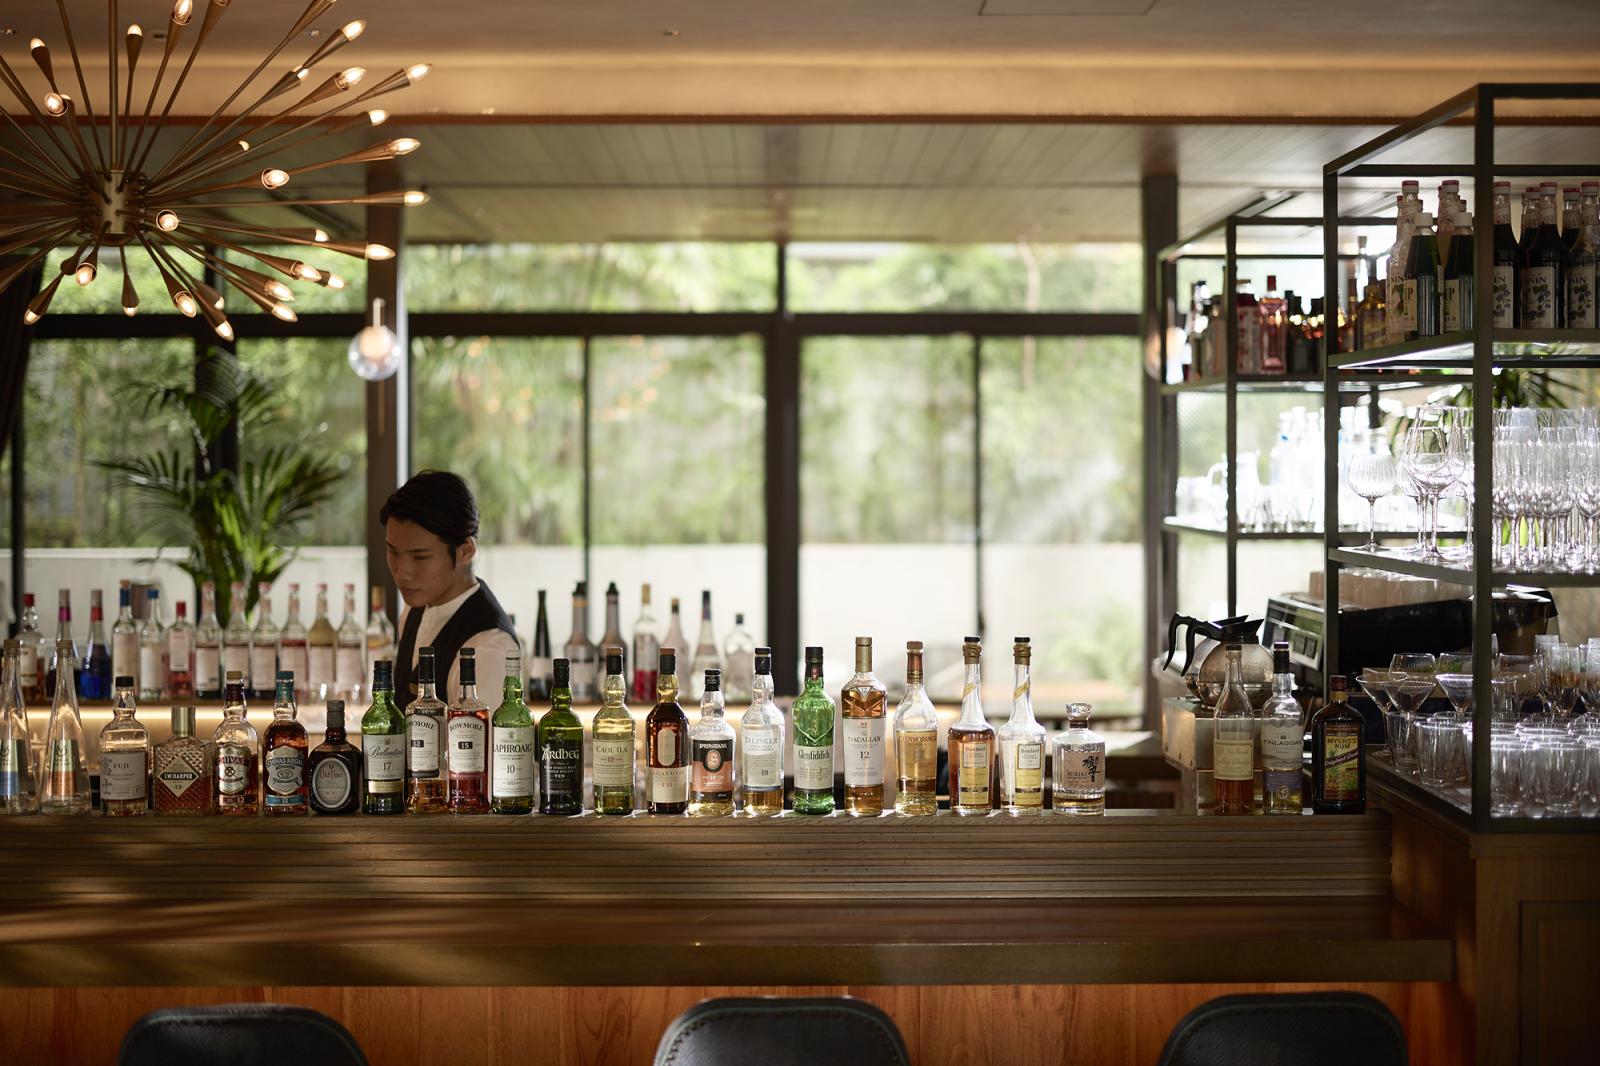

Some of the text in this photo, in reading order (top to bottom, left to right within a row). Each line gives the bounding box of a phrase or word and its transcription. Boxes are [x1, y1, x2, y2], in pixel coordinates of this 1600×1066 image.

[450, 723, 483, 731] BOWMORE
[860, 751, 870, 759] 12
[383, 762, 392, 771] 17
[507, 765, 516, 773] 10
